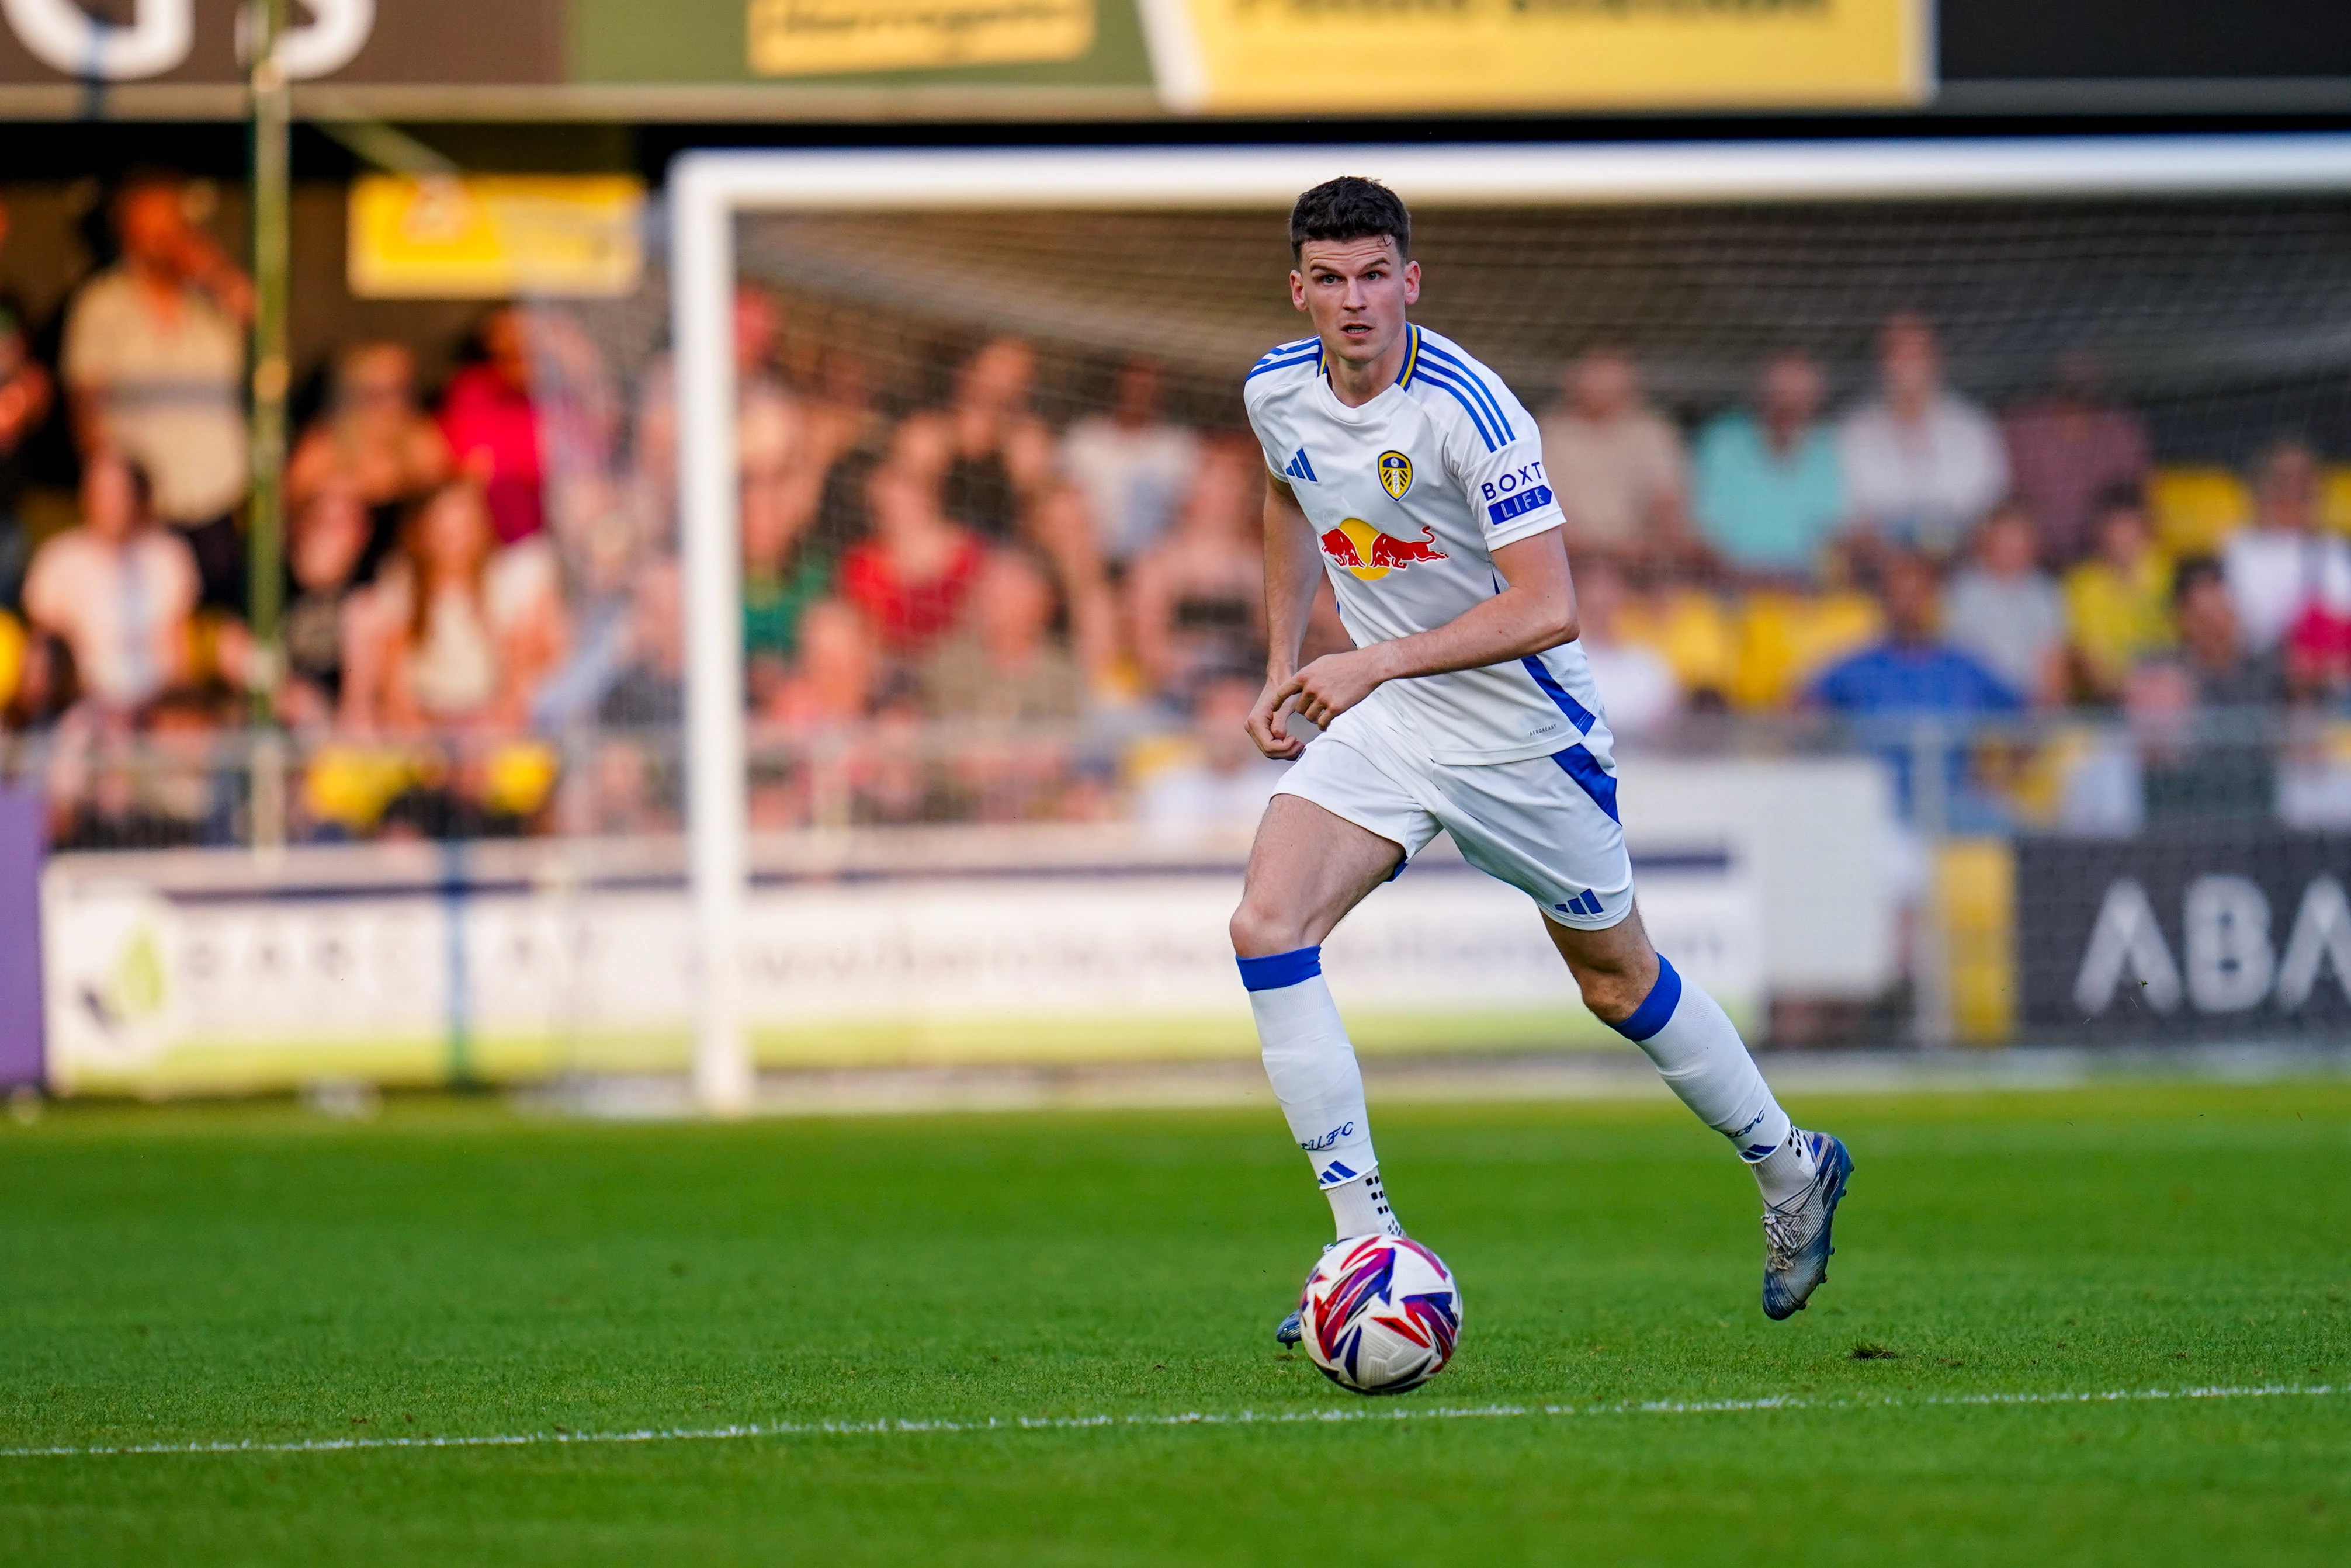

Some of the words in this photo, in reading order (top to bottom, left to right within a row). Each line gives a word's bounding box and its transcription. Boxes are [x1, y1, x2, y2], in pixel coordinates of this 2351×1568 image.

[1481, 461, 1542, 501] BOXT
[1500, 488, 1545, 518] LIFE
[1530, 724, 1556, 736] AEROREADY
